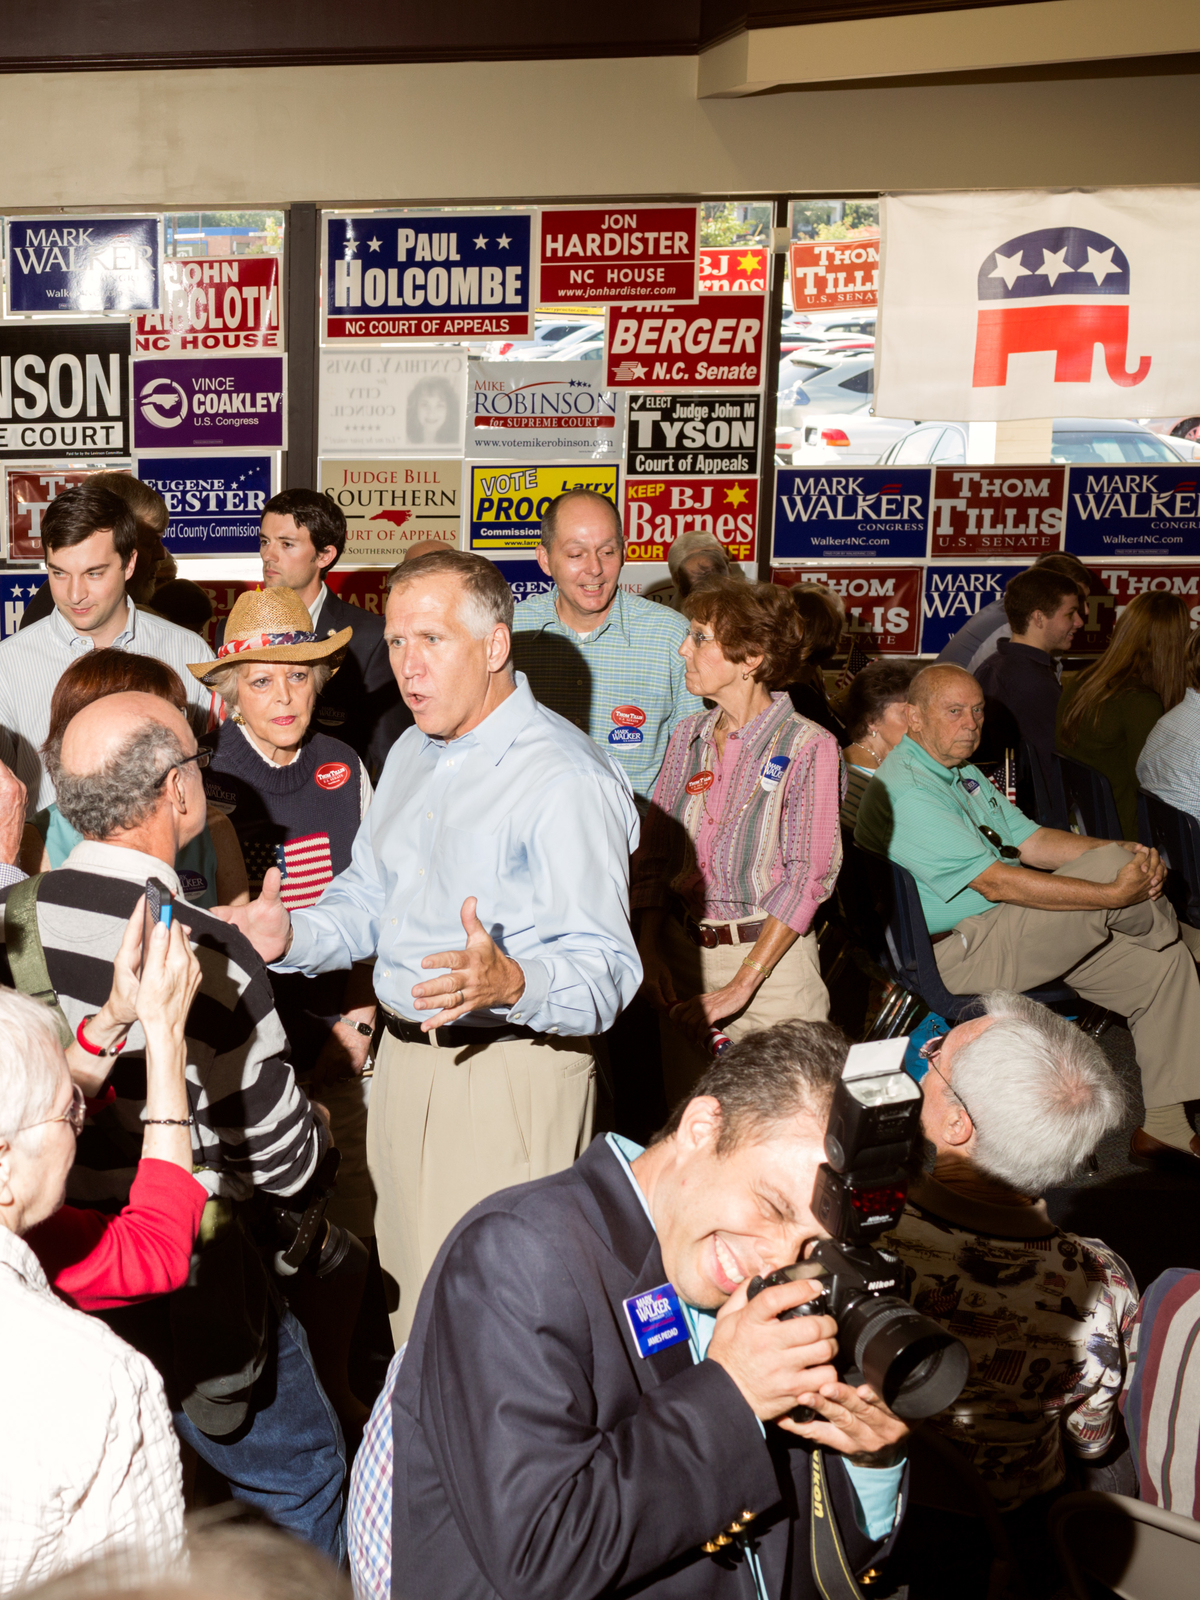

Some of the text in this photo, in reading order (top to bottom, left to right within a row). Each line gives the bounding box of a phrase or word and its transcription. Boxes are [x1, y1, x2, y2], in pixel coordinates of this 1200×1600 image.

[600, 213, 637, 230] JON
[25, 227, 95, 247] MARK
[397, 228, 460, 262] PAUL
[545, 231, 690, 257] HARDISTER
[13, 244, 156, 275] WALKER
[167, 261, 239, 285] JOHN
[569, 267, 665, 284] NC HOUSE
[334, 259, 522, 308] HOLCOMBE
[558, 286, 676, 298] www.jonhardister.com
[807, 295, 832, 304] U.S.
[345, 318, 510, 335] NC COURT OF APPEALS
[610, 318, 760, 354] BERGER
[136, 333, 278, 352] NC HOUSE
[652, 361, 757, 380] N.C. Senate
[192, 377, 235, 391] VINCE
[474, 379, 505, 392] MIKE
[192, 392, 281, 414] COAKLEY
[473, 391, 618, 415] ROBINSON
[645, 396, 672, 408] ELECT
[672, 402, 755, 421] Judge John M
[194, 417, 259, 428] U.S. Congress
[489, 417, 600, 428] for SUPREME COURT
[630, 411, 755, 448] TYSON
[20, 425, 116, 448] COURT
[474, 438, 614, 448] www.votemikerobinson.com
[635, 453, 749, 474] Court of Appeals
[142, 479, 225, 491] EUGENE
[342, 468, 441, 488] JUDGE BILL
[480, 468, 538, 497] VOTE
[561, 480, 615, 494] Larry
[793, 477, 865, 495] MARK
[953, 472, 1051, 498] THOM
[1085, 474, 1159, 493] MARK
[324, 487, 457, 507] SOUTHERN
[628, 483, 666, 499] KEEP
[669, 486, 714, 509] BJ
[779, 493, 925, 522] WALKER
[933, 498, 1062, 535] TILLIS
[628, 501, 754, 543] Barnes
[857, 523, 924, 531] CONGRESS
[177, 523, 208, 541] County
[377, 529, 457, 541] OF APPEALS
[810, 536, 890, 546] Walker4NC.com
[939, 536, 1051, 547] U.S. SENATE
[1102, 534, 1183, 544] Walker4NC.com
[627, 544, 665, 560] OUR
[930, 573, 1003, 592] MARK
[1101, 570, 1200, 595] THOM
[611, 732, 641, 741] WALKER
[867, 1279, 895, 1291] Nikon
[635, 1297, 672, 1323] WALKER
